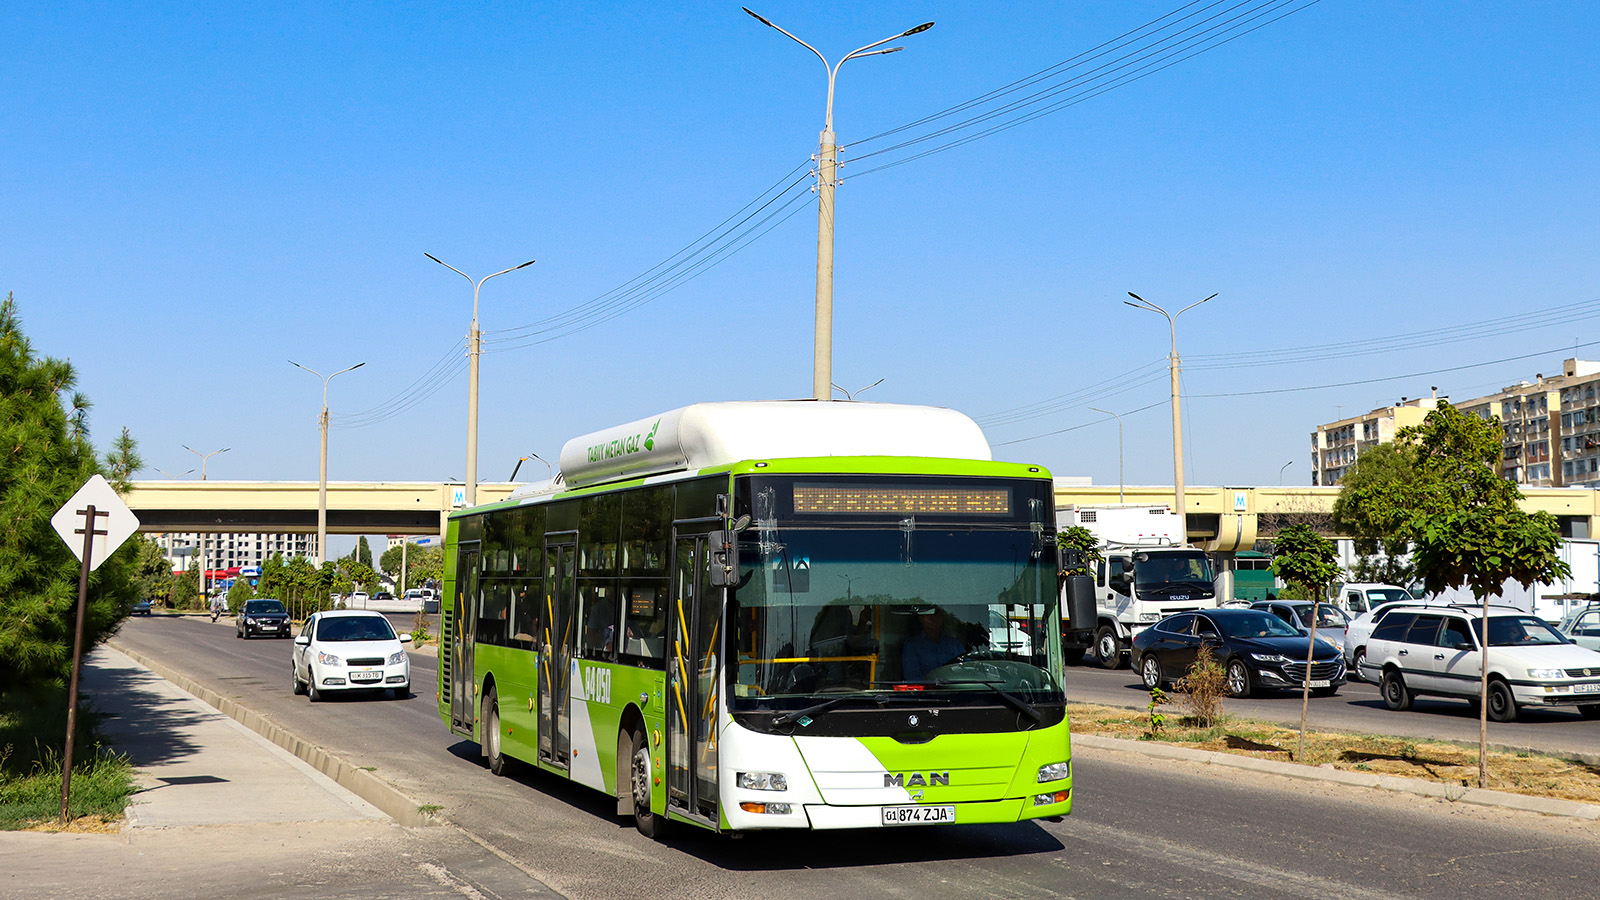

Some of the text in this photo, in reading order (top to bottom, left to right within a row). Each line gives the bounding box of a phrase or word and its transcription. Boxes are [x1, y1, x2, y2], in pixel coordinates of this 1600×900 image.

[605, 438, 626, 460] METAN
[626, 434, 641, 454] GAZ
[1236, 495, 1246, 507] M
[884, 772, 949, 787] MAN
[886, 808, 948, 821] 01 874 ZJA
